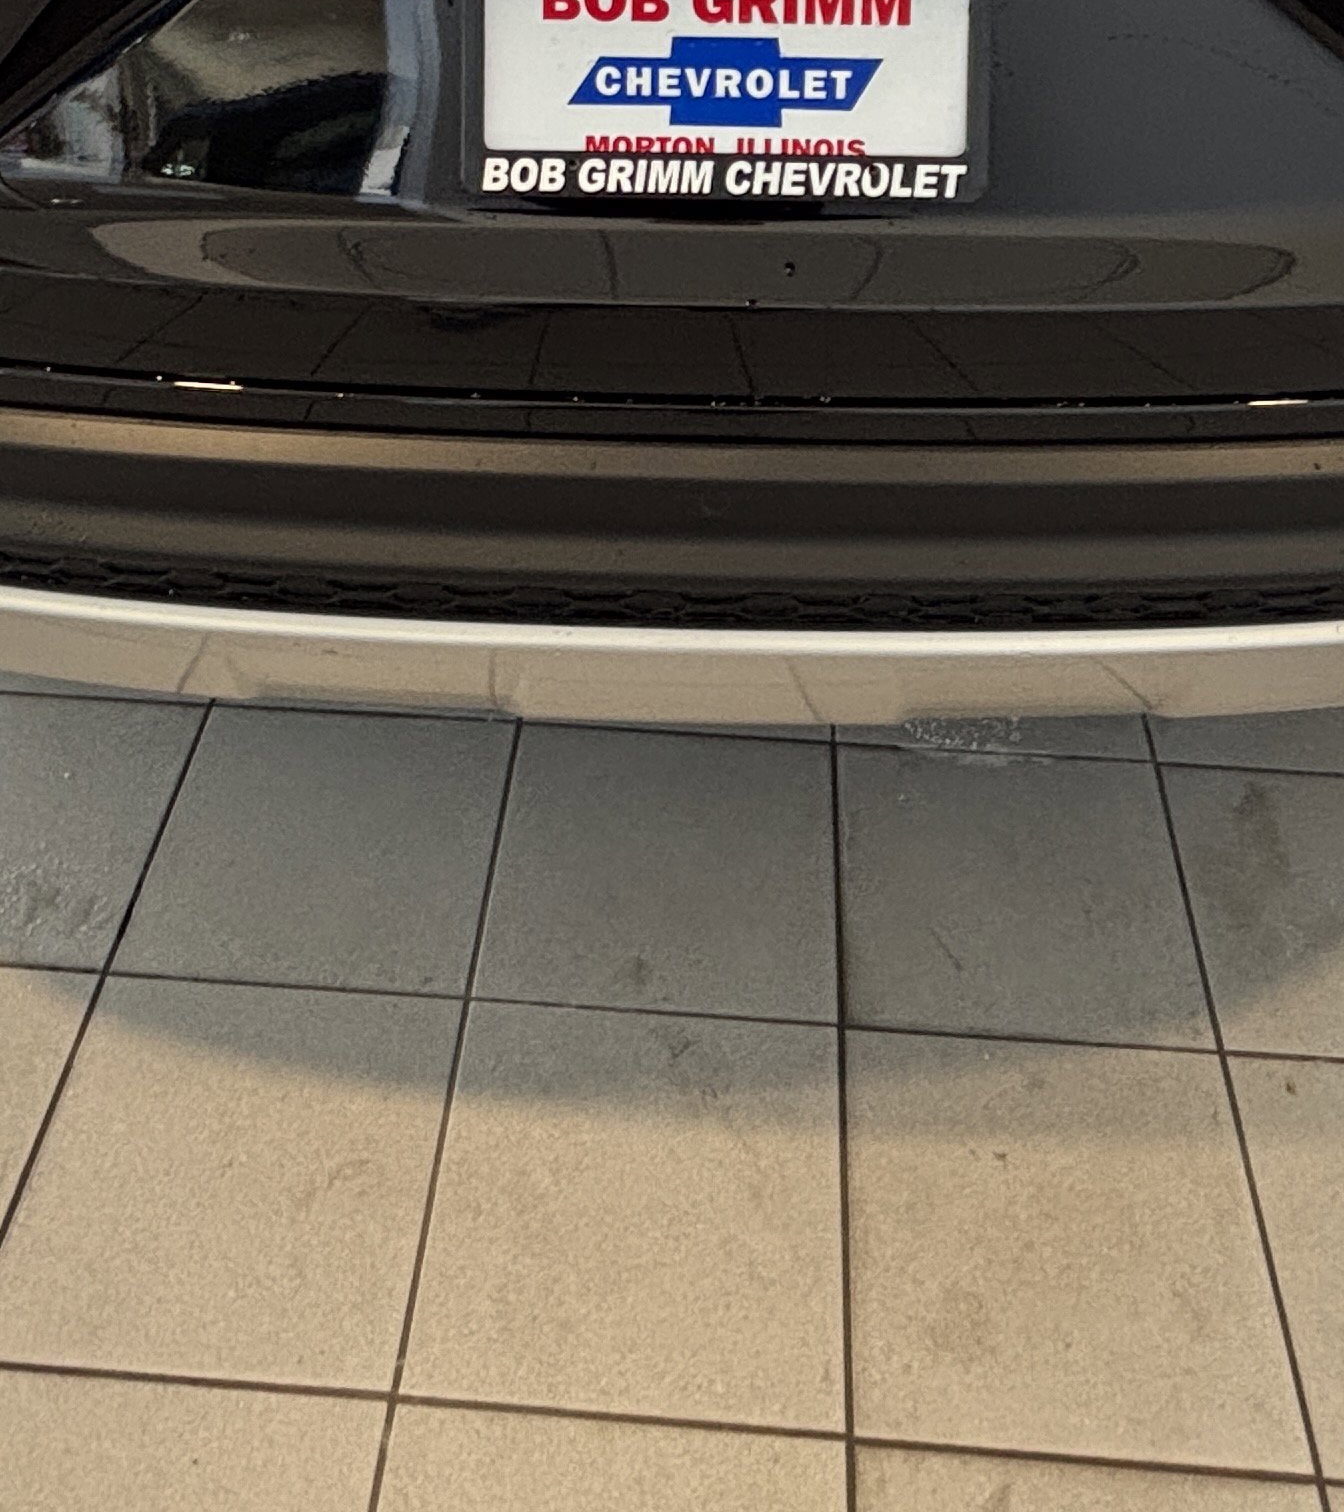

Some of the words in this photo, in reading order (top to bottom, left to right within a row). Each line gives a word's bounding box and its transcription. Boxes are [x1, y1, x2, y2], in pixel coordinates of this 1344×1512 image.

[594, 65, 854, 101] CHEVROLET
[482, 157, 566, 193] BOB
[577, 158, 715, 195] GRIMM
[725, 160, 968, 199] CHEVROLET
